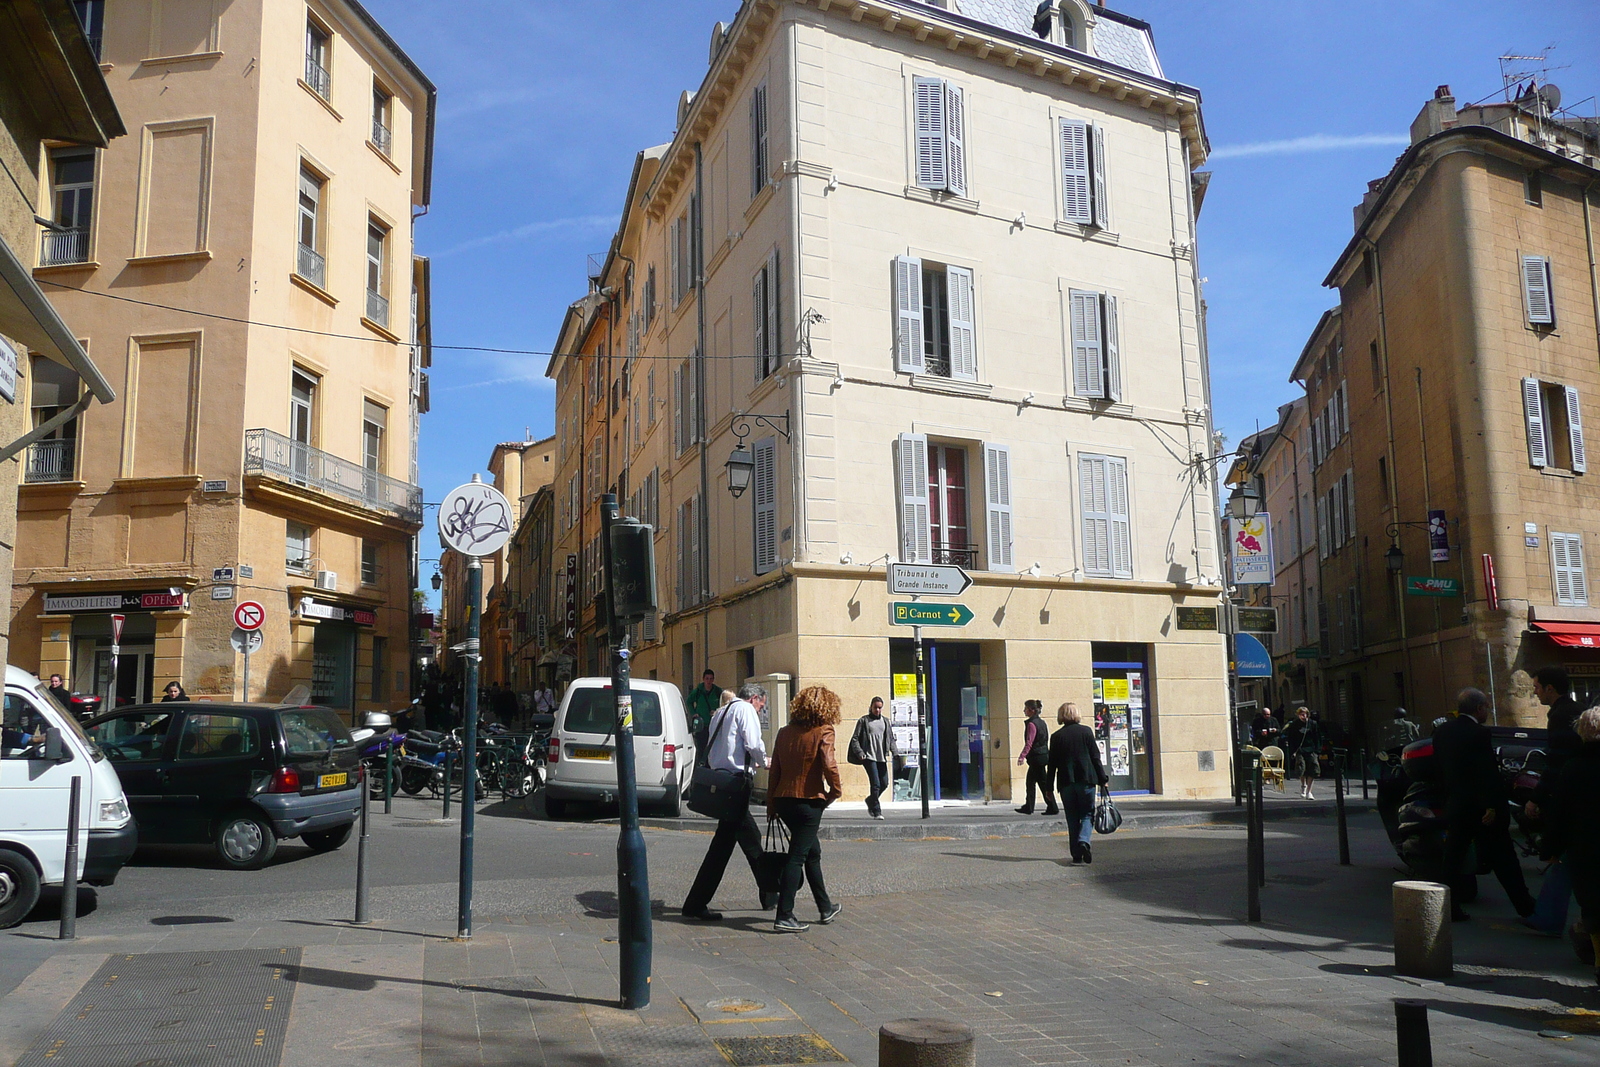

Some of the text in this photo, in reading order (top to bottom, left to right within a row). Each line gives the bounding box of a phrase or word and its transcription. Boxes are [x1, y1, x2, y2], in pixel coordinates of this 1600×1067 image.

[897, 569, 927, 578] Tribunal
[898, 580, 948, 589] Grande Instance
[1427, 579, 1452, 587] PMU
[47, 597, 118, 609] IMMOBILIÈRE
[122, 596, 140, 605] aix
[566, 557, 575, 639] SNACK
[909, 608, 941, 619] Carnot
